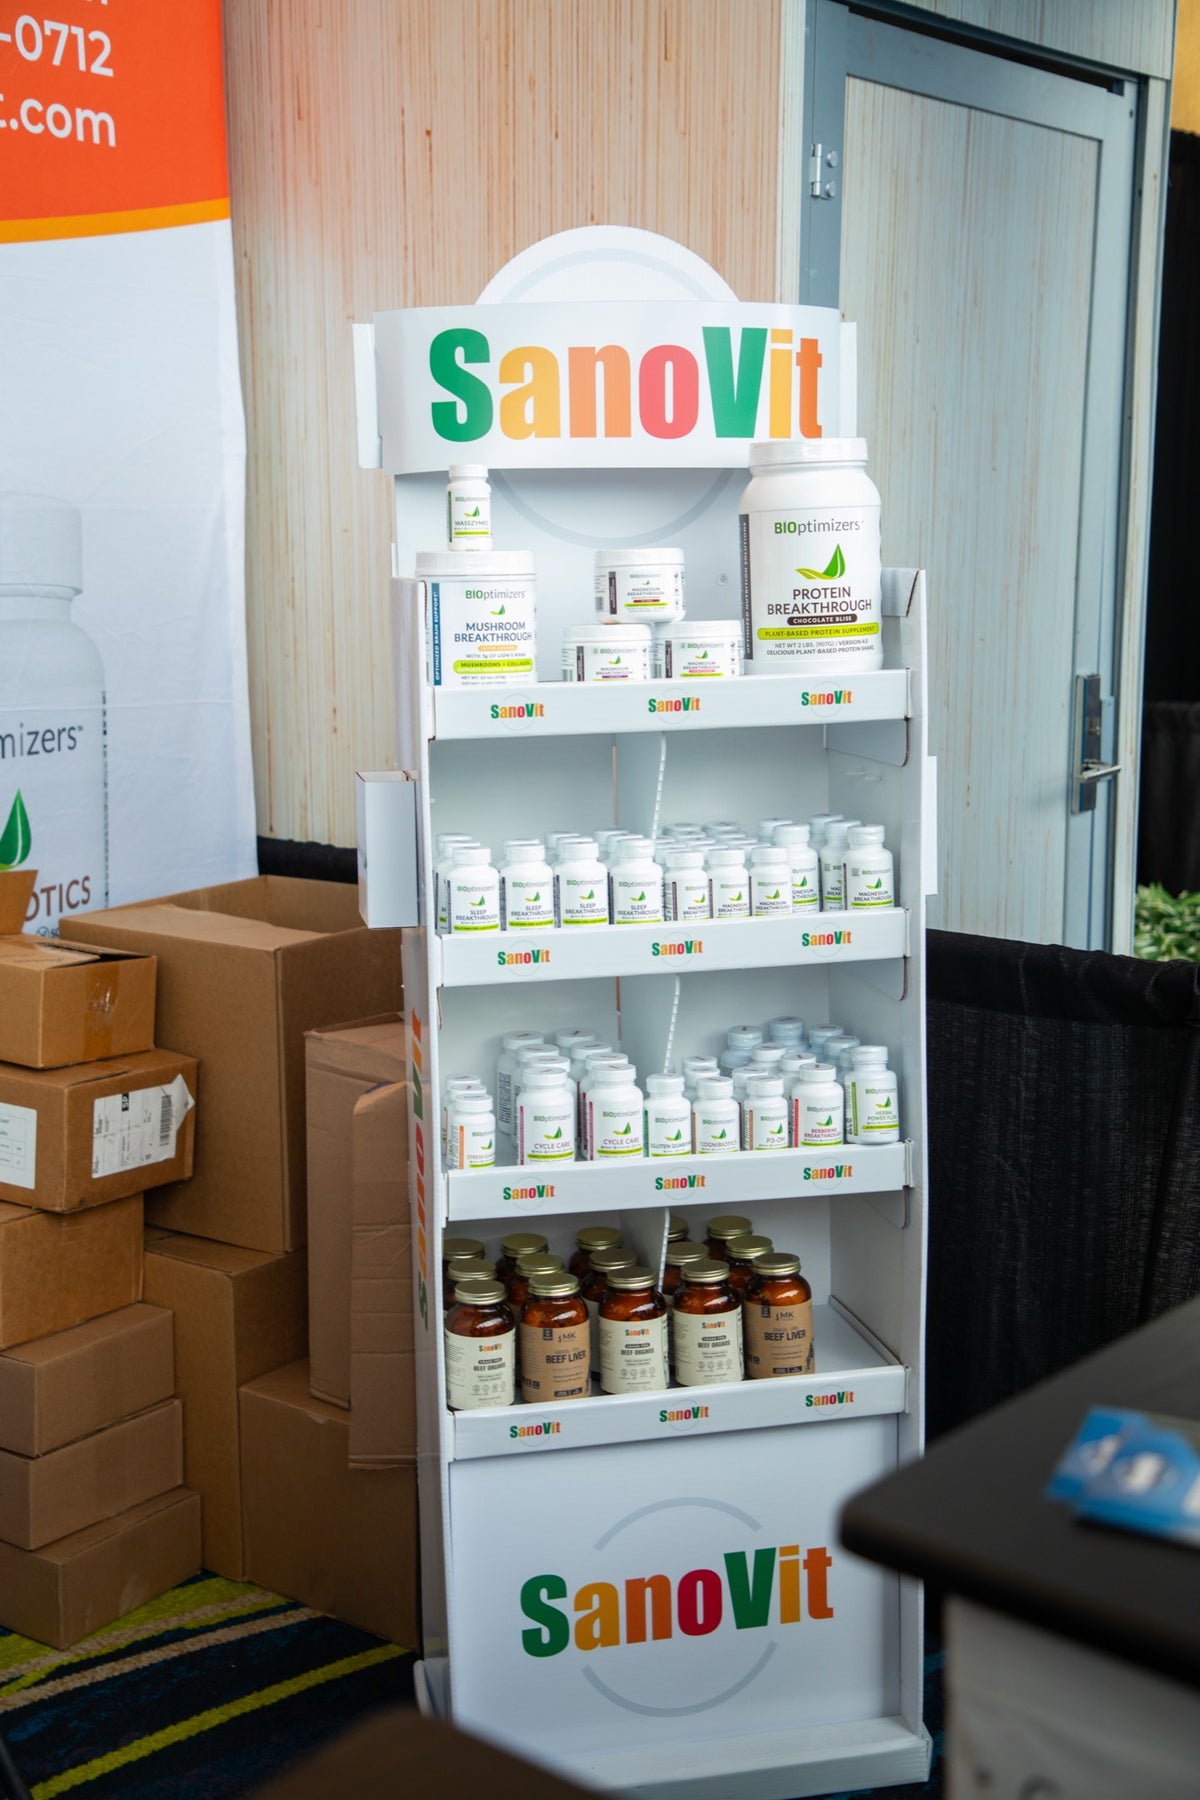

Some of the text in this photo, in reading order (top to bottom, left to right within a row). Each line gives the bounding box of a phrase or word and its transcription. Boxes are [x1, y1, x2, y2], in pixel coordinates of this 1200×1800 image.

[429, 326, 823, 442] SanoVit
[773, 518, 864, 536] BIOptimizers
[793, 586, 851, 601] PROTEIN
[767, 599, 872, 615] BREAKTHROUGH
[466, 621, 526, 631] MUSHROOM
[454, 631, 532, 642] BREAKTHROUGH
[648, 697, 701, 713] SanoVit
[801, 690, 852, 706] SanoVit
[490, 702, 545, 719] SanoVit
[801, 930, 852, 947] SanoVit
[652, 940, 703, 956] SanoVit
[497, 949, 550, 966] SanoVit
[411, 1007, 428, 1332] SanoVit
[803, 1165, 853, 1181] SanoVit
[655, 1174, 706, 1191] SanoVit
[503, 1184, 555, 1201] SanoVit
[764, 1329, 806, 1341] BEEF LIVER
[545, 1350, 586, 1364] BEEF LIVER
[805, 1391, 855, 1408] SanoVit
[659, 1406, 710, 1423] SanoVit
[509, 1421, 561, 1439] SanoVit
[520, 1544, 834, 1658] SanoVit
